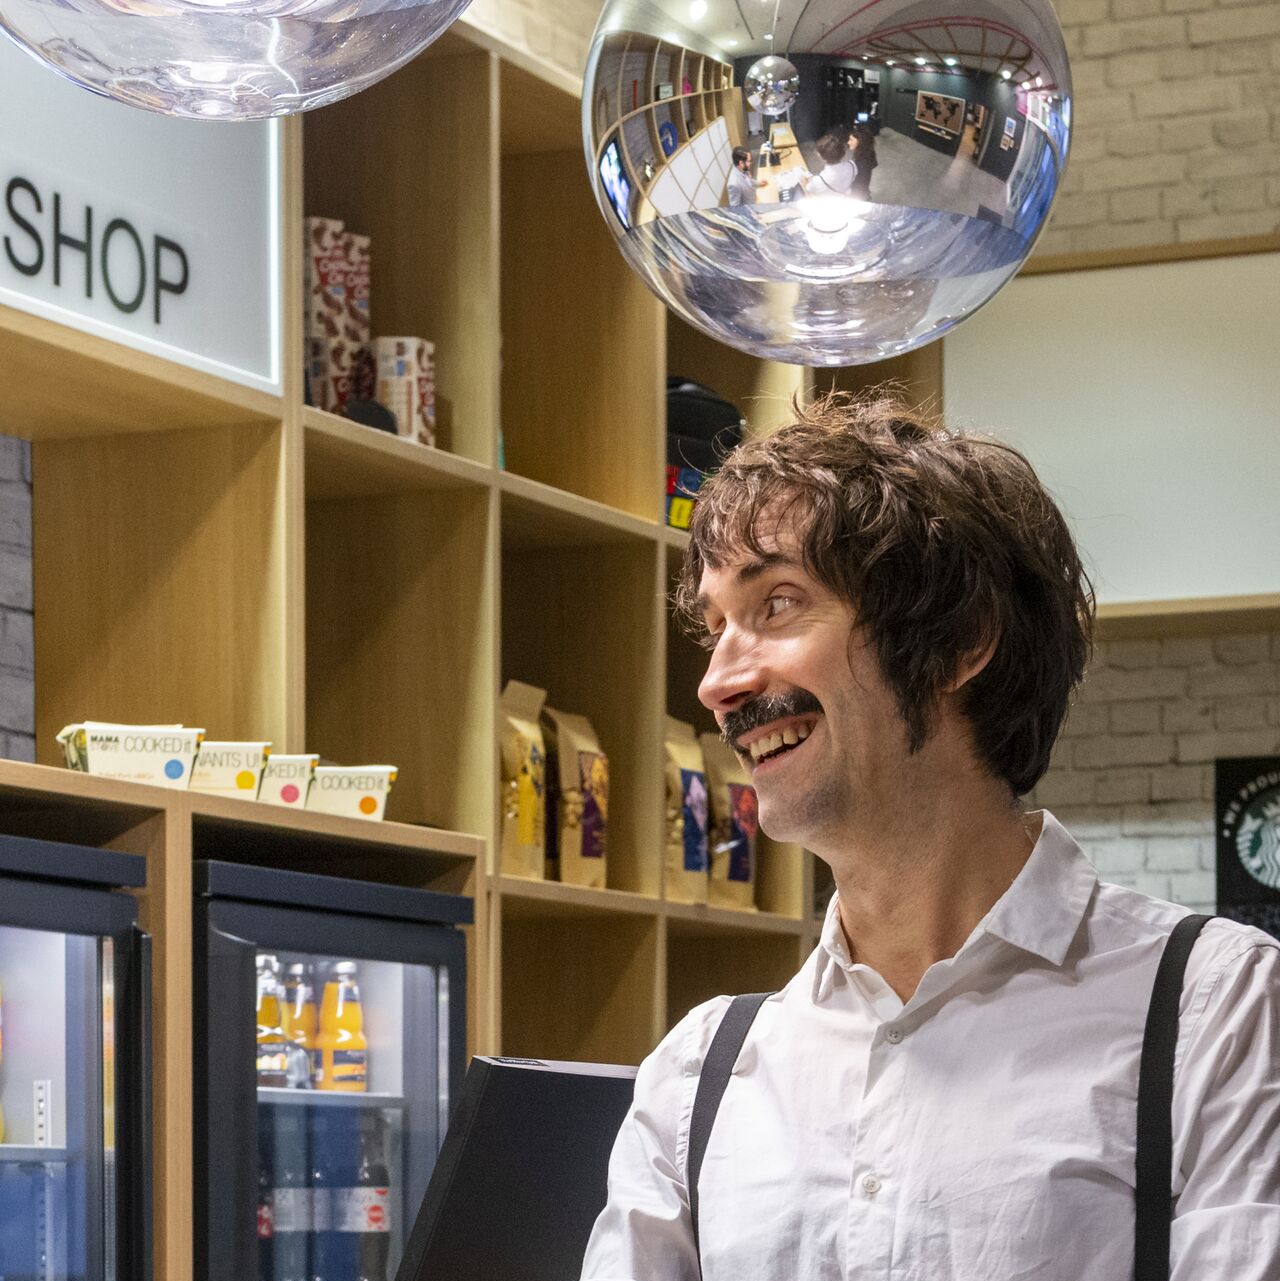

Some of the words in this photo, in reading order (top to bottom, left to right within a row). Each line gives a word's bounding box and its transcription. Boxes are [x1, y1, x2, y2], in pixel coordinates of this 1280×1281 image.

[3, 176, 189, 325] SHOP
[90, 735, 119, 743] MAMA
[124, 735, 183, 753] COOKED
[183, 737, 192, 753] it
[321, 774, 376, 791] COOKED
